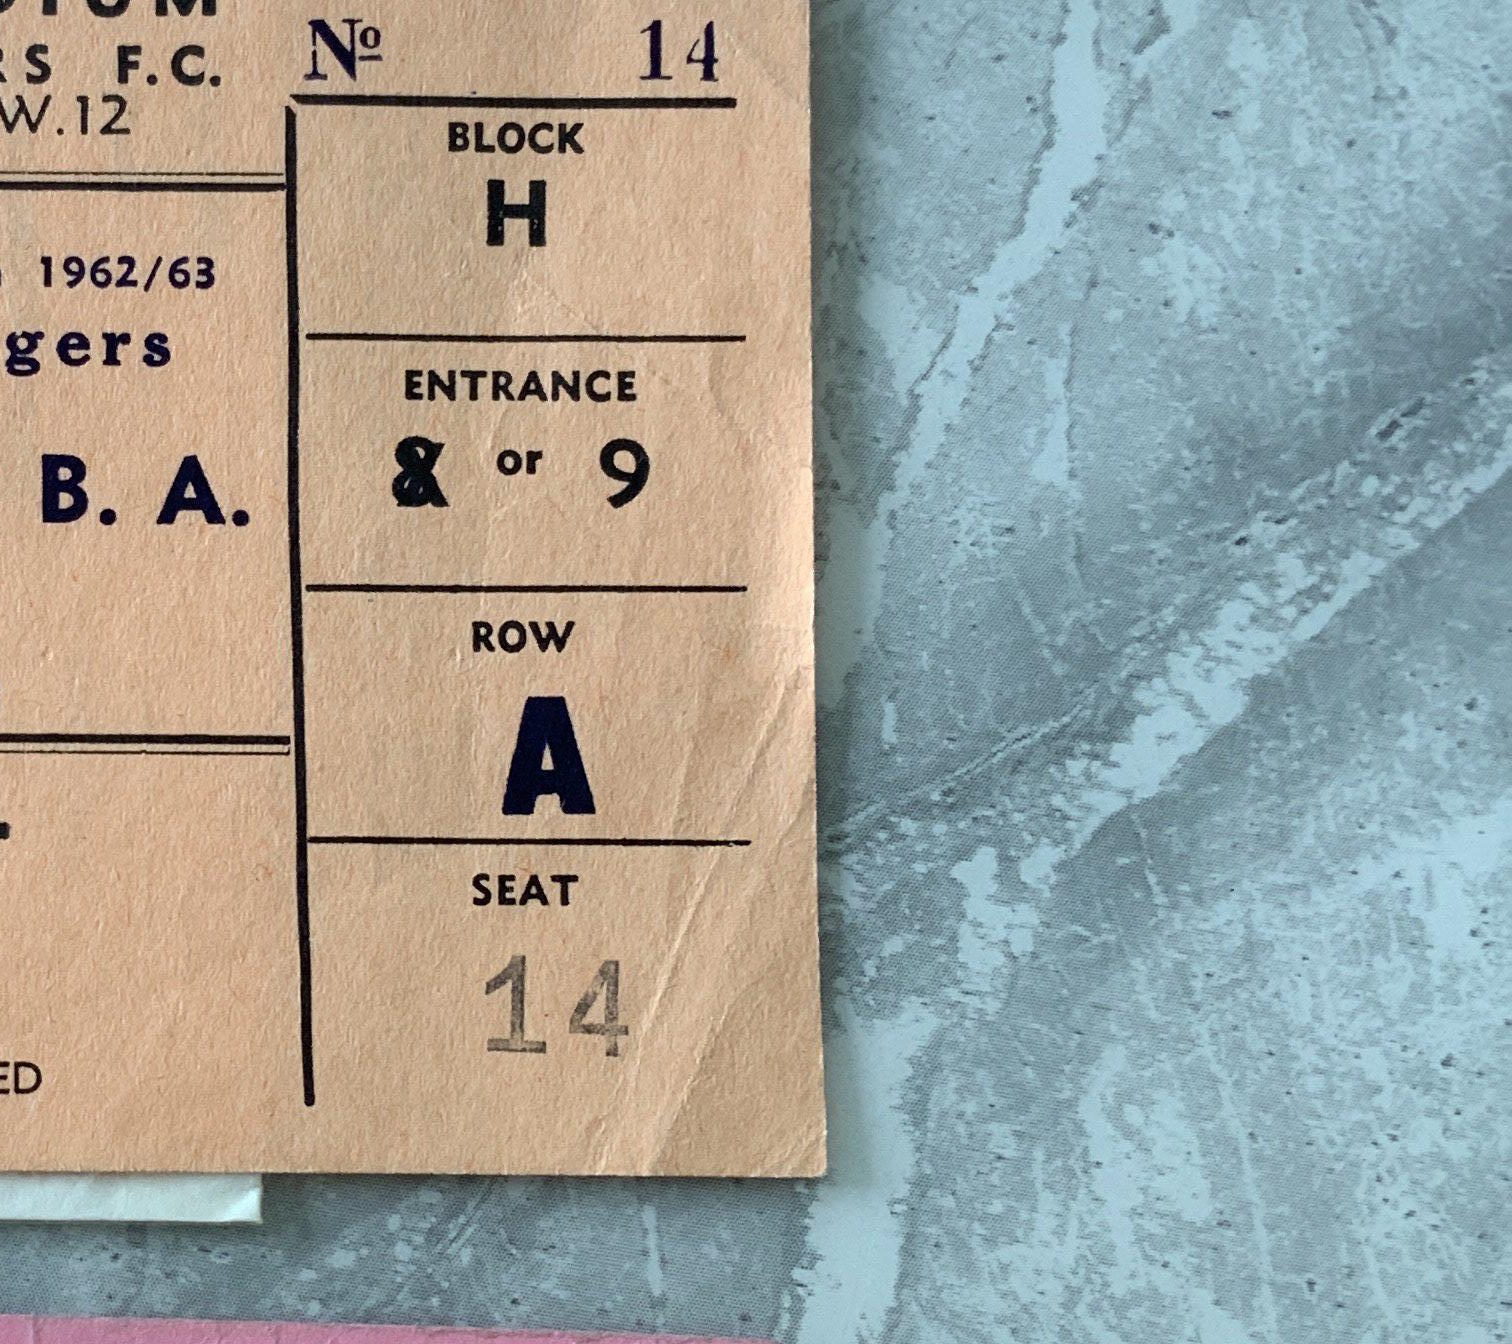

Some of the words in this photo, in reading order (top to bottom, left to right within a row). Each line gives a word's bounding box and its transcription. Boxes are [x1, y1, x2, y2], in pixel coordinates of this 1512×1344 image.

[117, 44, 221, 87] F.C.
[639, 19, 719, 82] 14
[448, 121, 585, 155] BLOCK
[486, 178, 547, 248] H
[40, 255, 215, 293] 1962/63
[404, 369, 637, 403] ENTRANCE
[41, 453, 117, 526] B.
[155, 454, 250, 527] A.
[496, 449, 543, 476] or
[599, 438, 651, 509] 9
[471, 619, 576, 654] ROW
[501, 695, 596, 816] A
[472, 872, 579, 907] SEAT
[484, 954, 630, 1058] 14
